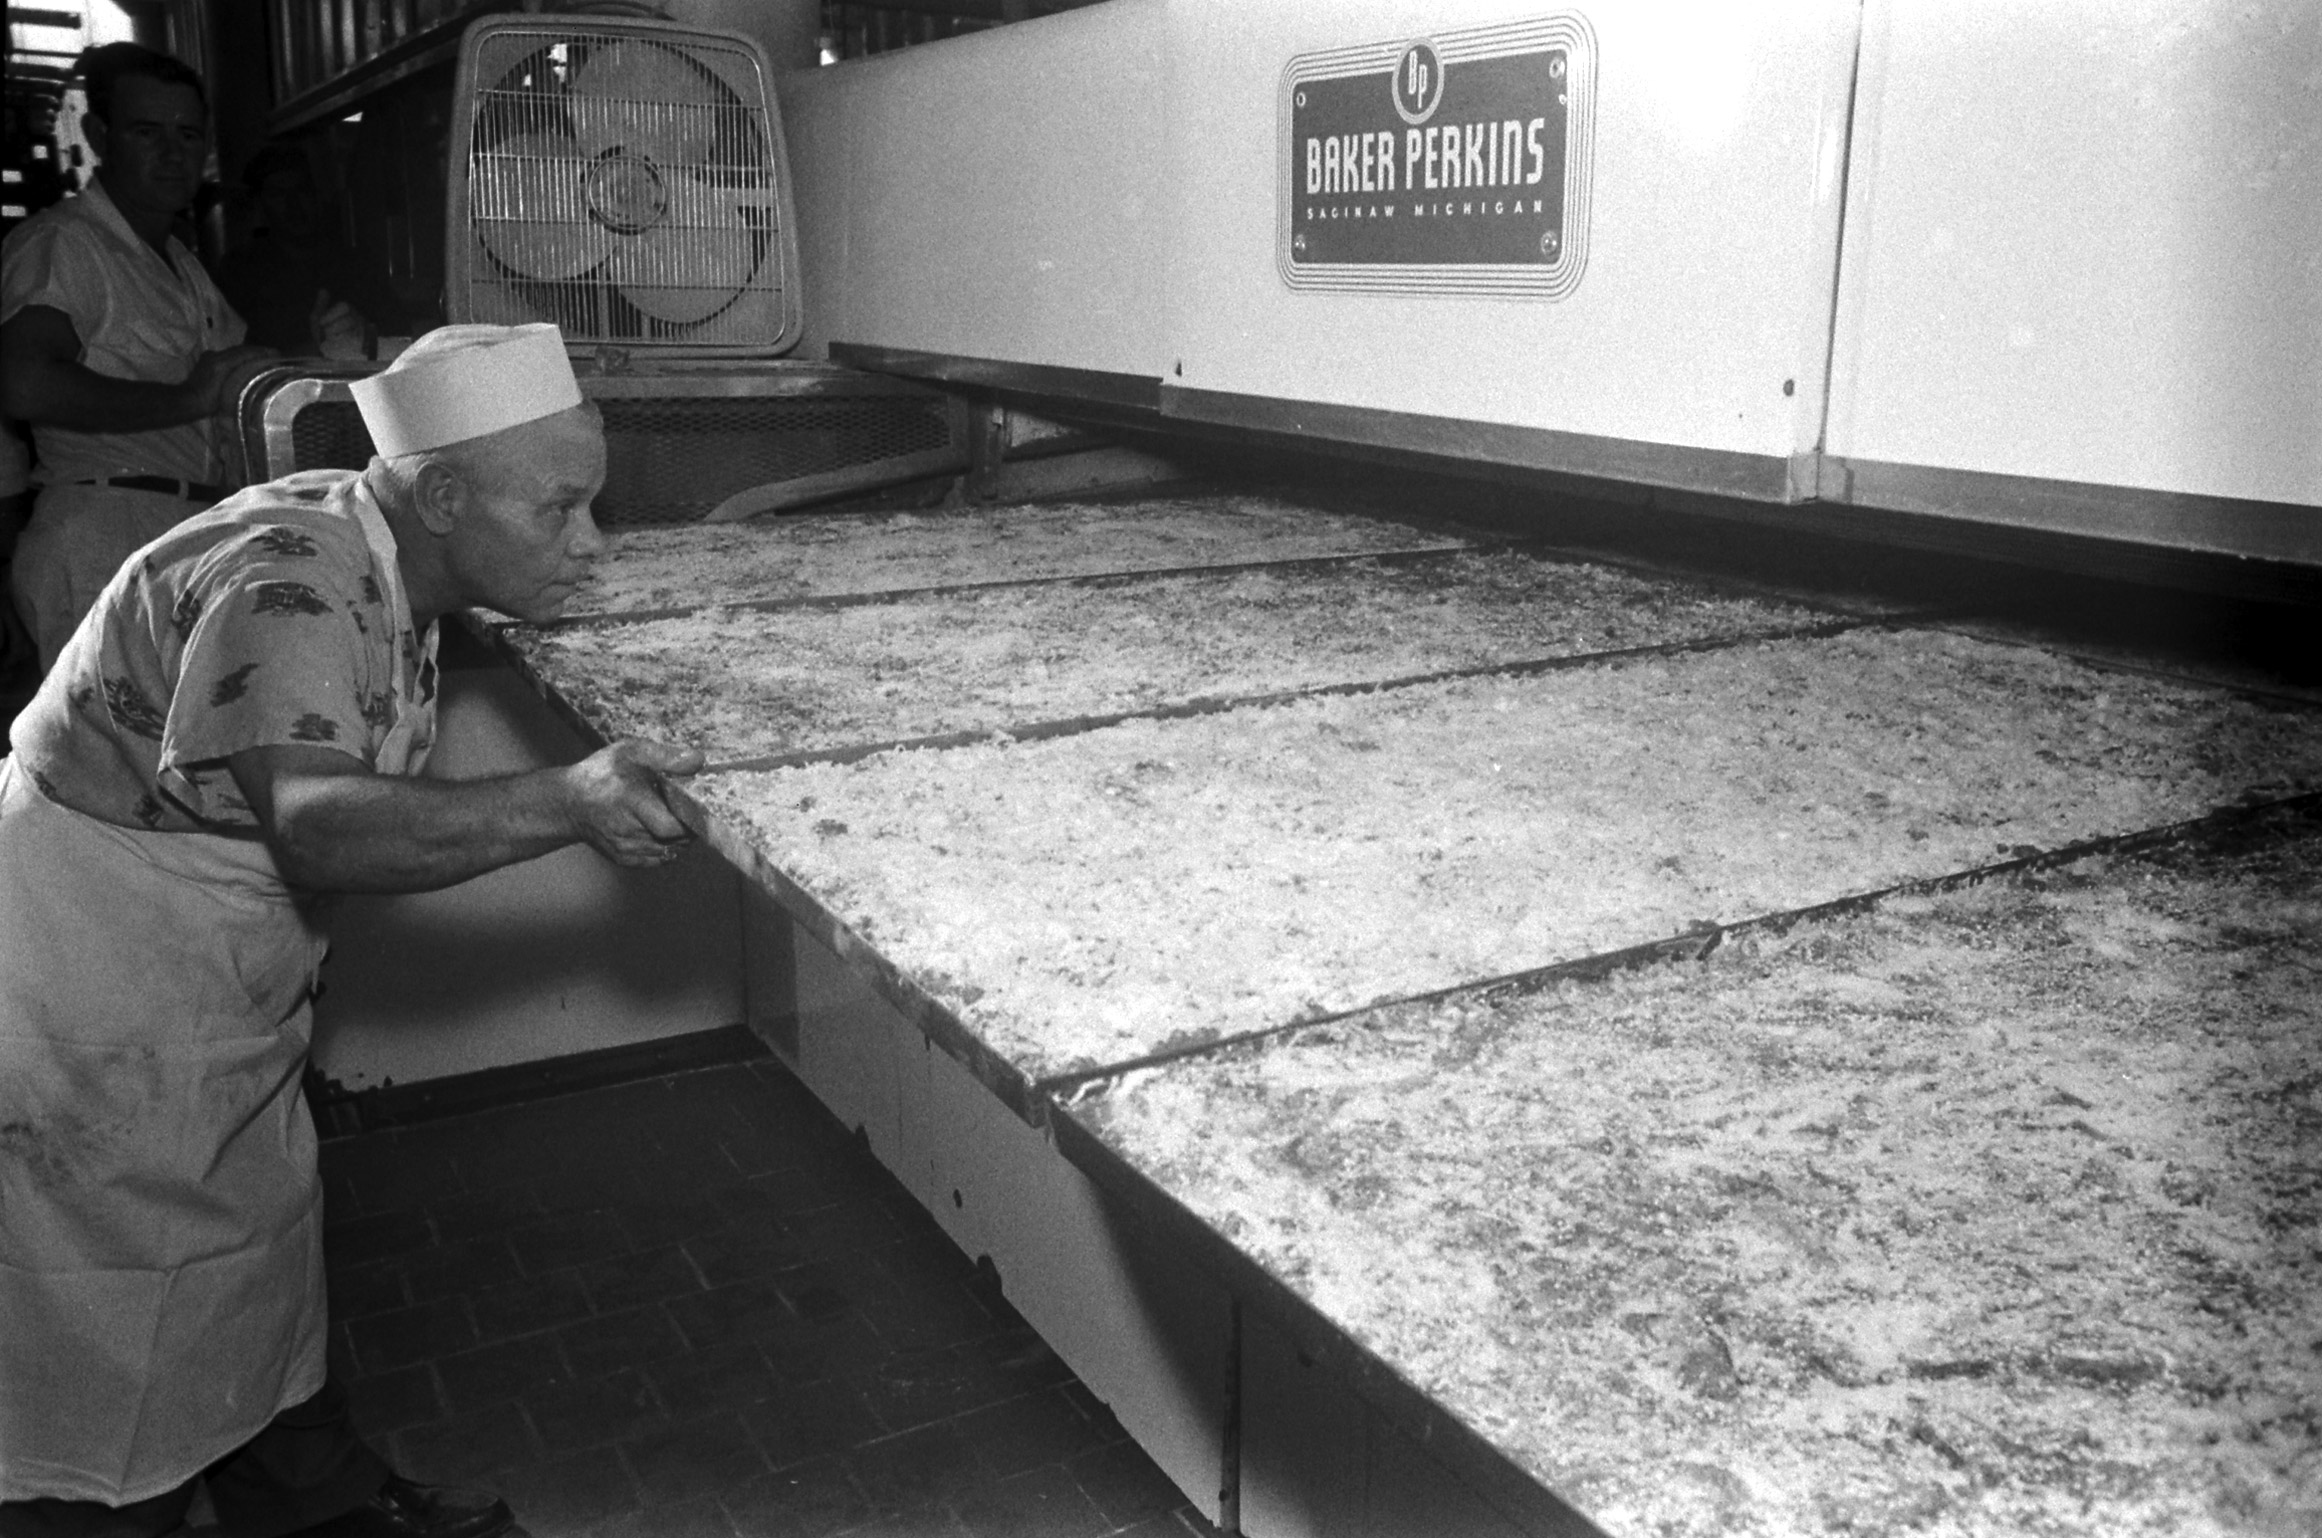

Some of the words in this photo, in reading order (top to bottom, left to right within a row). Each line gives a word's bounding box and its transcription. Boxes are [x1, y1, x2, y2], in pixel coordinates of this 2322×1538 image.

[1306, 131, 1395, 194] BAKER
[1405, 118, 1545, 190] PERKINS
[1307, 205, 1395, 220] SAGINAW
[1414, 200, 1542, 217] MICHIGAN
